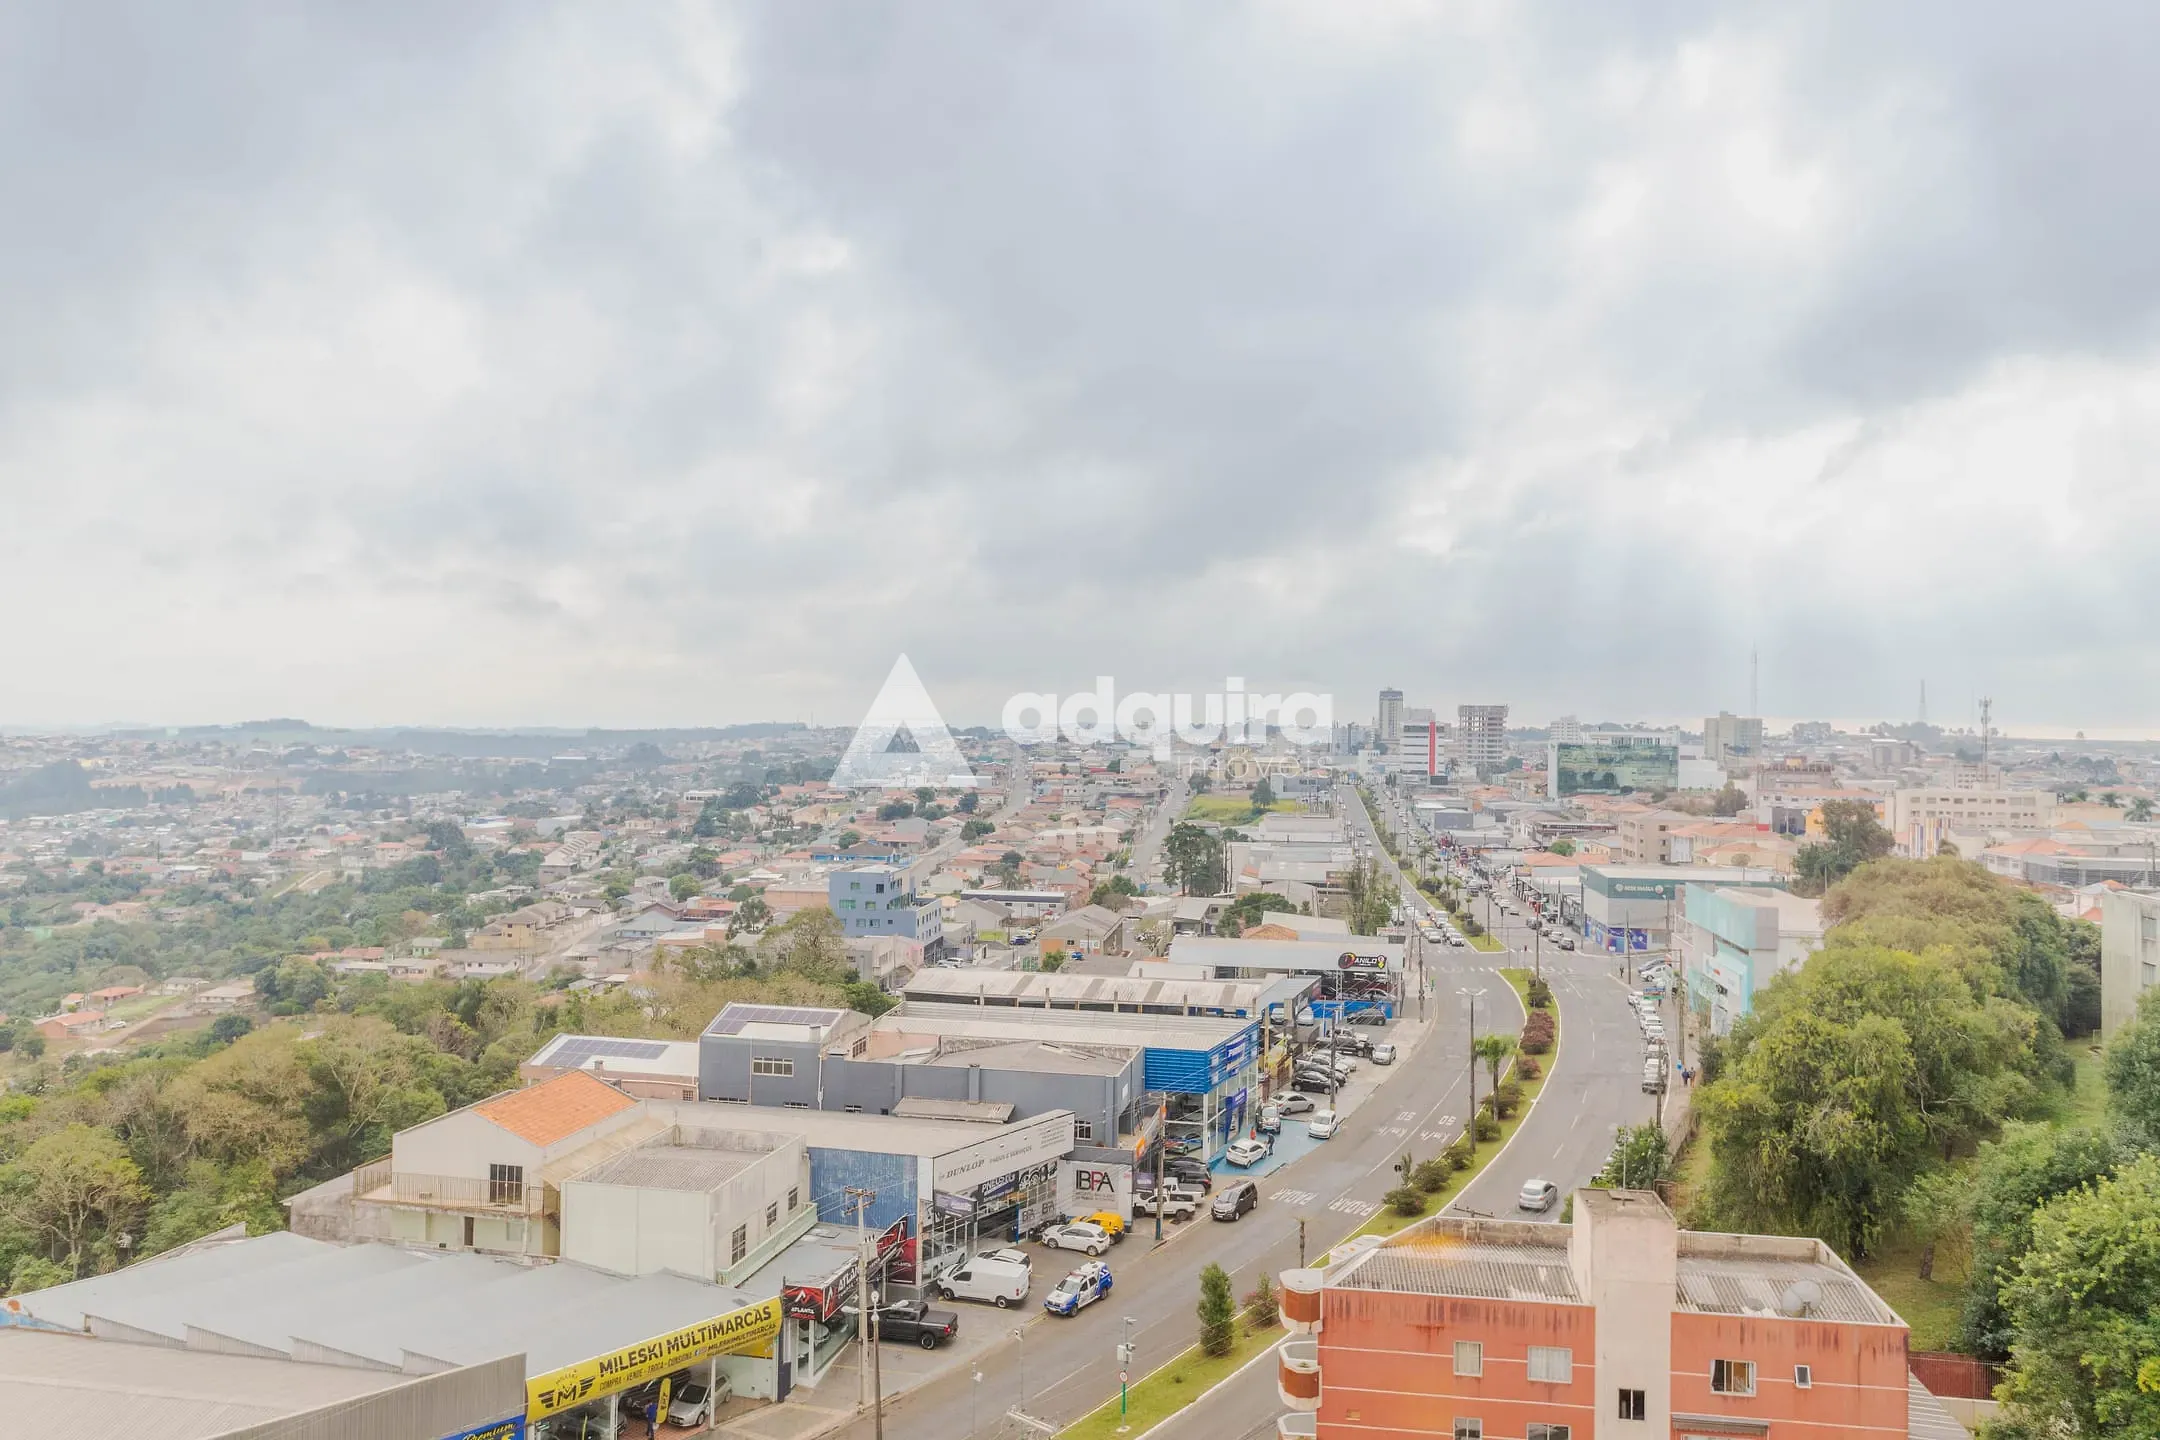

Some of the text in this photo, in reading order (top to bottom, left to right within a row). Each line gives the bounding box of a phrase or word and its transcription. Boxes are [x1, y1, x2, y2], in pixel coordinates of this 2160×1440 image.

[945, 1159, 985, 1179] DUNLOP
[1327, 1198, 1380, 1217] RADAR
[599, 1342, 664, 1378] MILESKI
[666, 1305, 772, 1356] MULTIMARCAS
